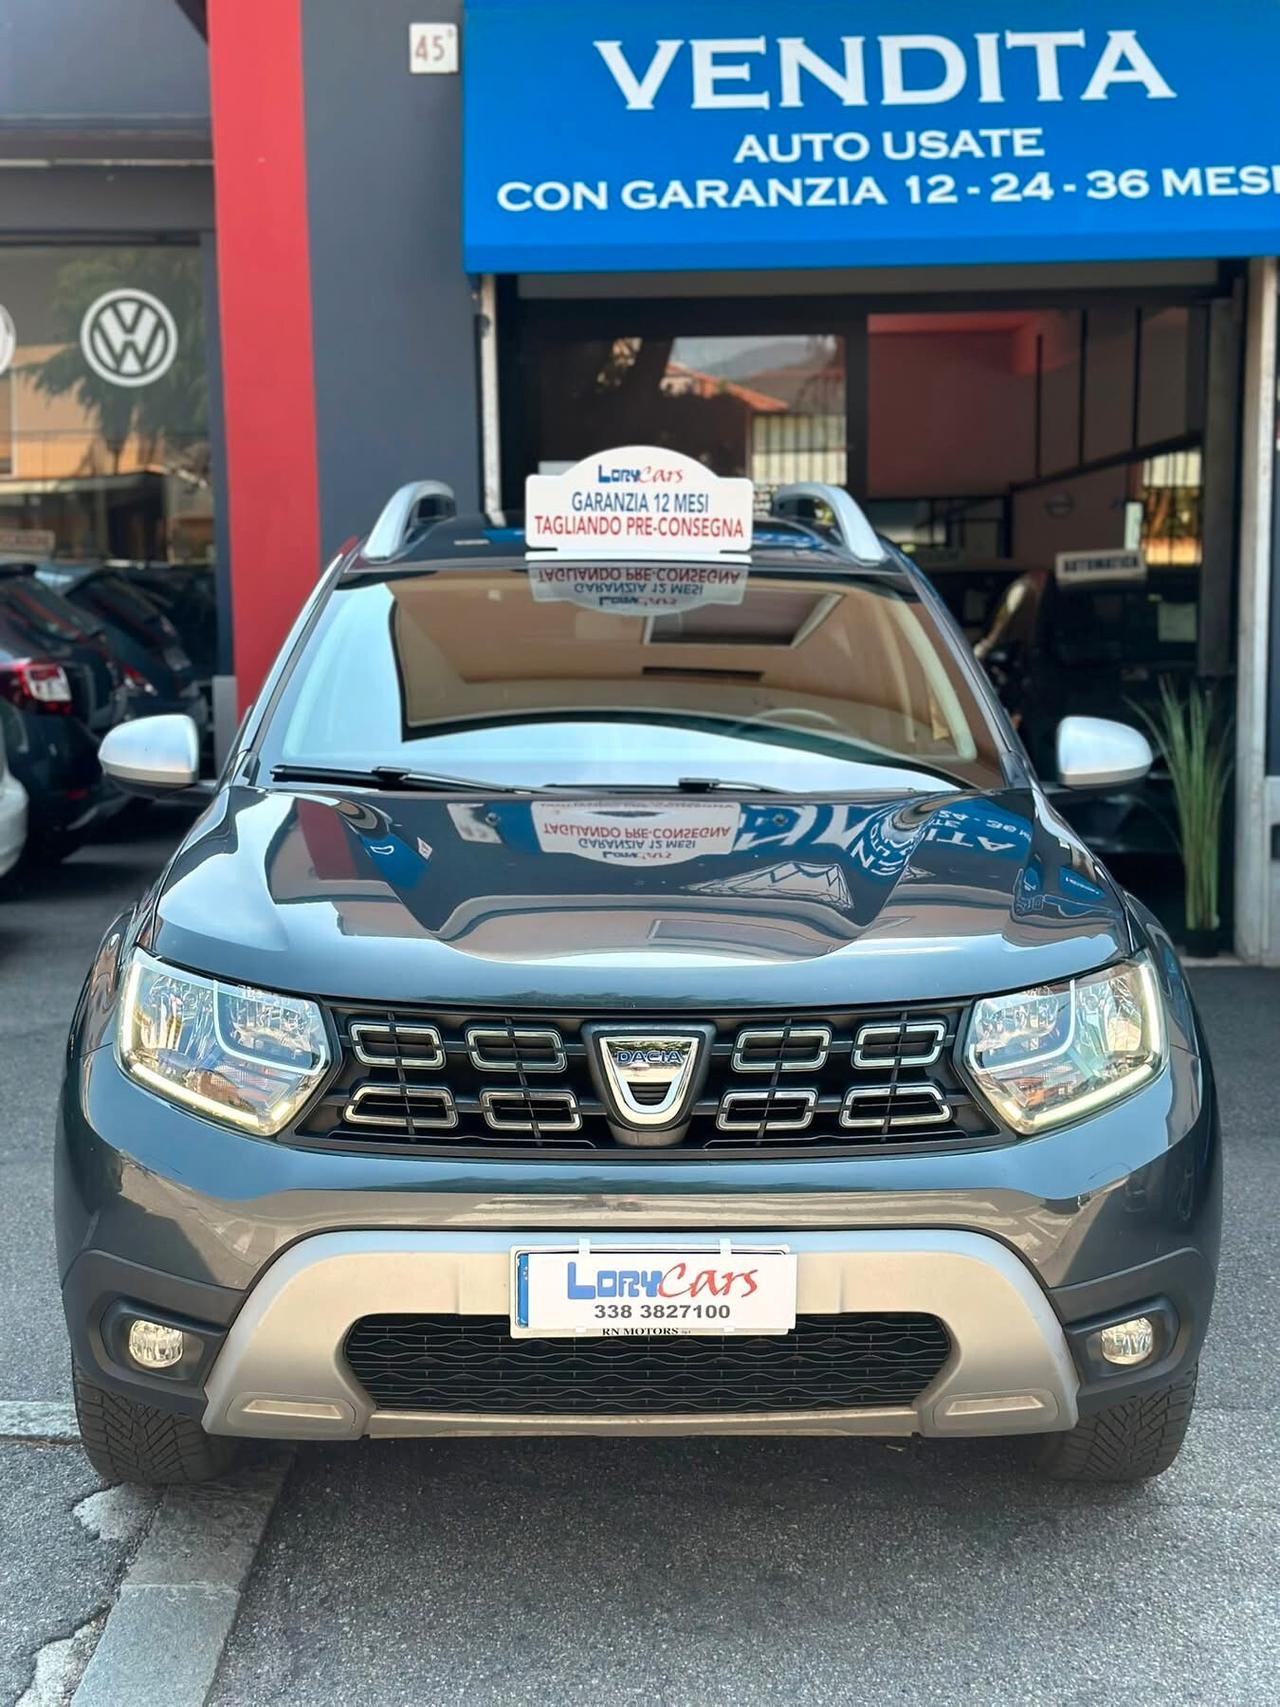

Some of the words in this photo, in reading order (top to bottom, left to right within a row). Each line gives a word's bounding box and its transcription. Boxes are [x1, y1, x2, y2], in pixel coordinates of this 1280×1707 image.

[593, 29, 1178, 111] VENDITA
[733, 131, 870, 163] AUTO
[882, 127, 1045, 160] USATE
[496, 180, 608, 212] CON
[620, 175, 888, 210] GARANZIA
[905, 173, 958, 204] 12
[990, 171, 1054, 202] 24
[1086, 168, 1150, 199] 36
[571, 491, 649, 513] GARANZIA
[654, 492, 671, 513] 12
[673, 493, 709, 513] MESI
[534, 515, 622, 536] TAGLIANDO
[626, 516, 744, 538] PRE-CONSEGNA
[616, 1050, 684, 1064] DACIA
[594, 1304, 632, 1319] 338
[640, 1304, 731, 1319] 3827100
[602, 1327, 620, 1336] RN
[623, 1327, 679, 1336] MOTORS
